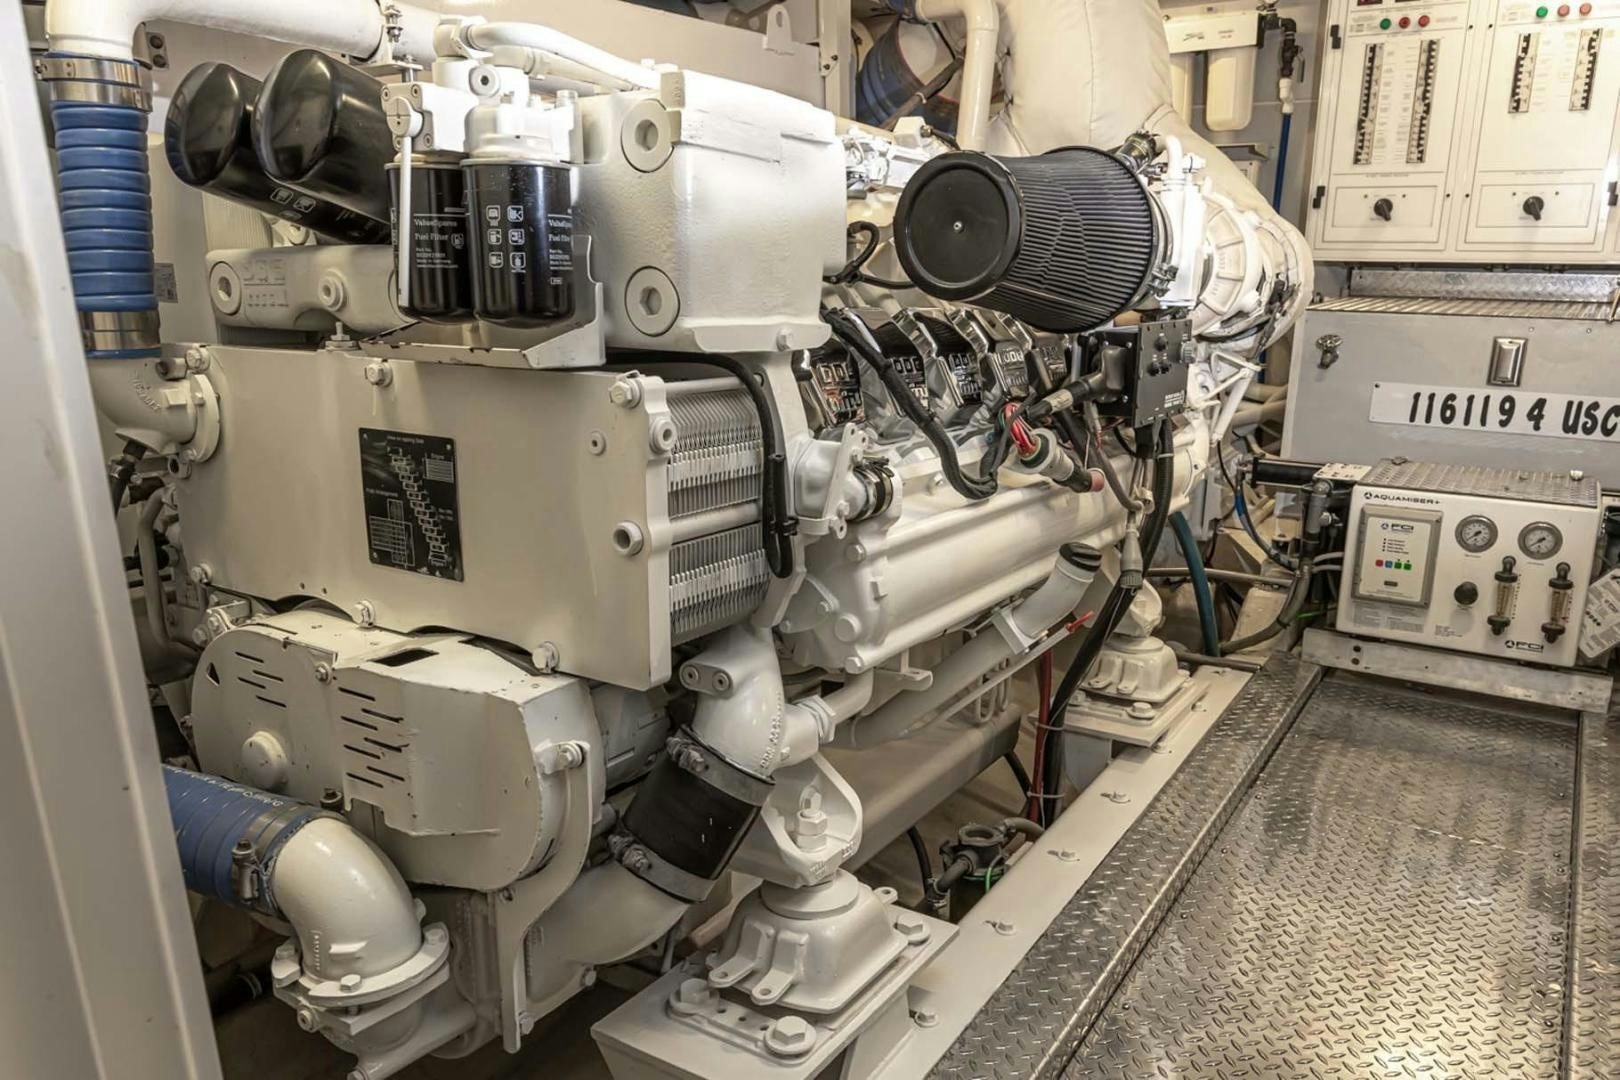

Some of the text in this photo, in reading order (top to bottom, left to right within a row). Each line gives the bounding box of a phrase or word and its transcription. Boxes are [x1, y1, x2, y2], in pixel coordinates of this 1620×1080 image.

[414, 233, 449, 241] Fuel Filter
[1373, 494, 1441, 505] AQUAMISER+
